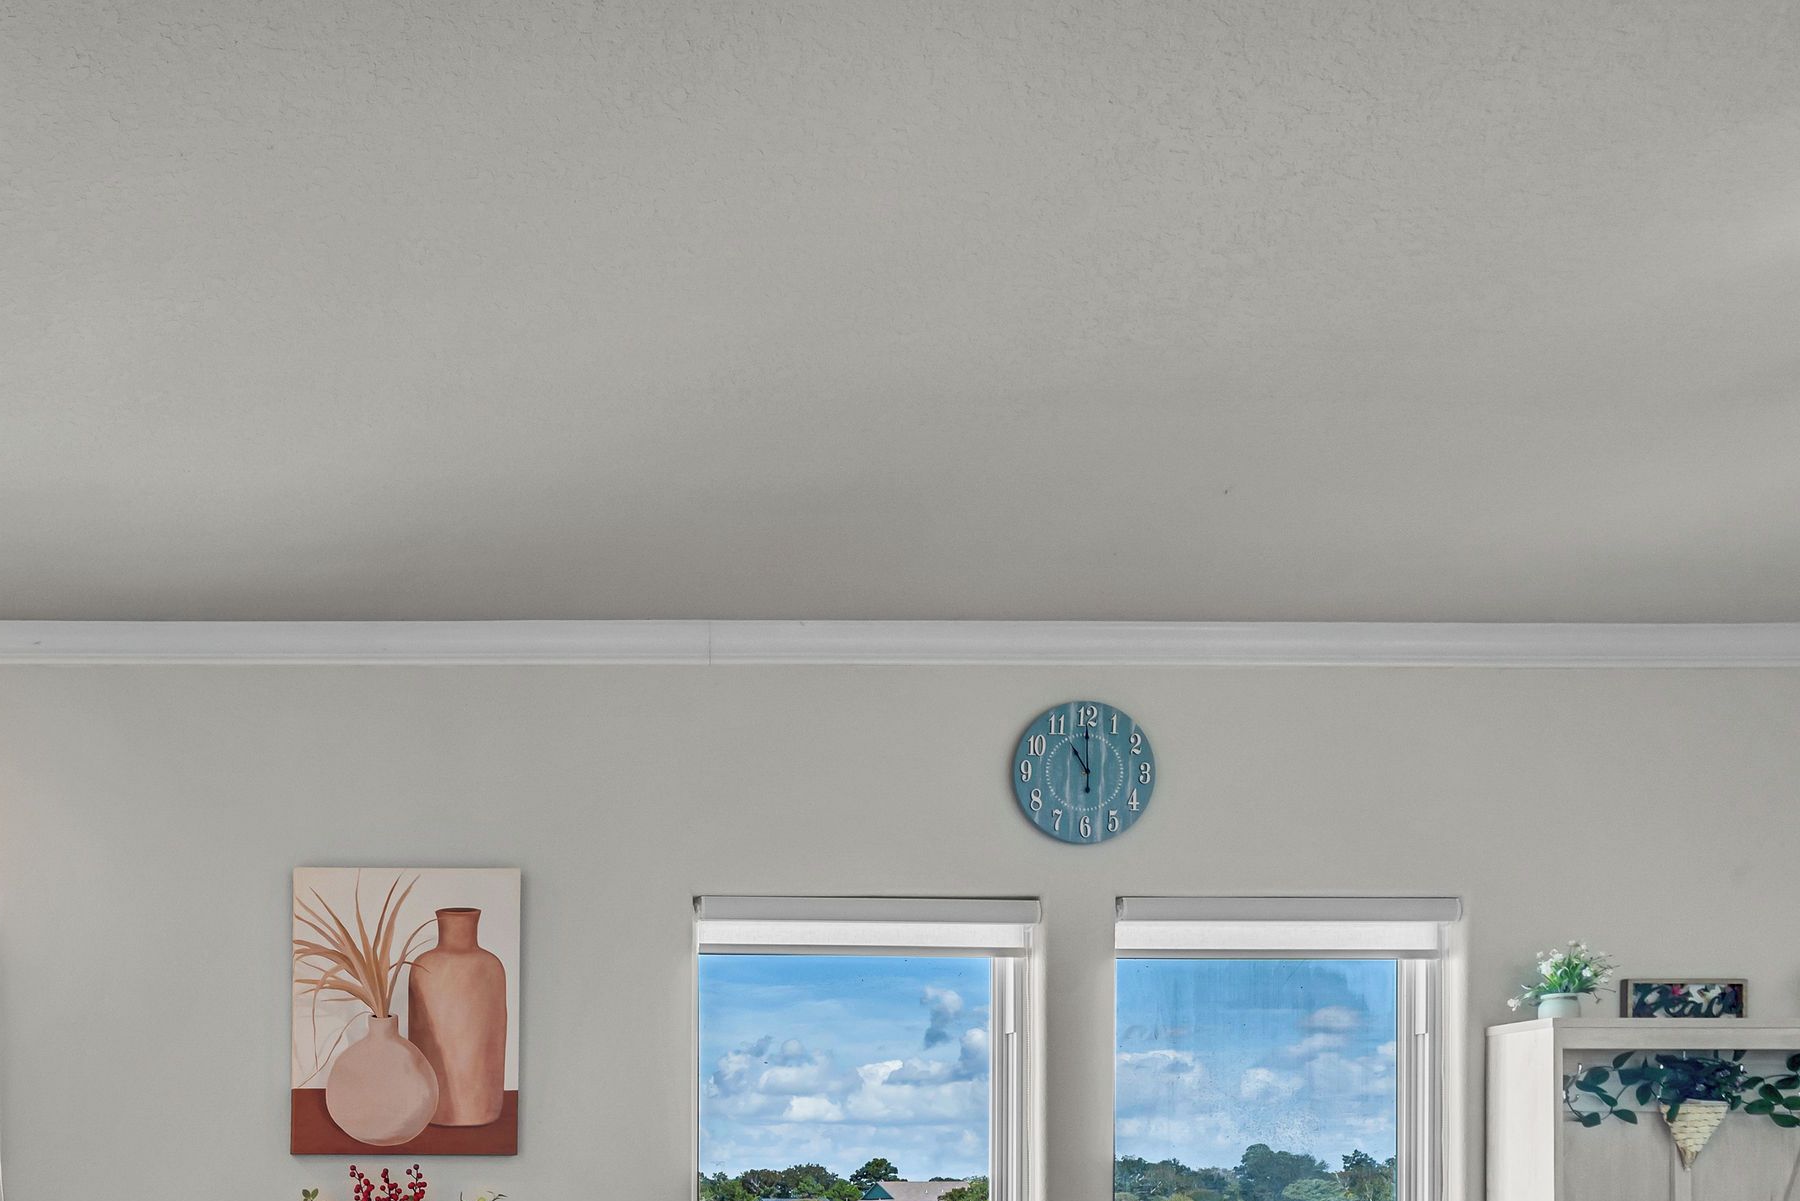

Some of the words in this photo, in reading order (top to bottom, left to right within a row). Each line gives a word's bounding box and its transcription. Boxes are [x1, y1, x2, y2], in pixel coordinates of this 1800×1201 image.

[1049, 714, 1065, 735] 11
[1078, 706, 1097, 727] 12
[1110, 714, 1118, 734] 1
[1028, 734, 1046, 757] 10
[1130, 733, 1142, 755] 2
[1020, 760, 1032, 782] 9
[1139, 763, 1151, 784] 3
[1030, 788, 1042, 811] 8
[1127, 789, 1139, 811] 4
[1052, 809, 1062, 831] 7
[1080, 816, 1091, 838] 6
[1108, 810, 1118, 832] 5
